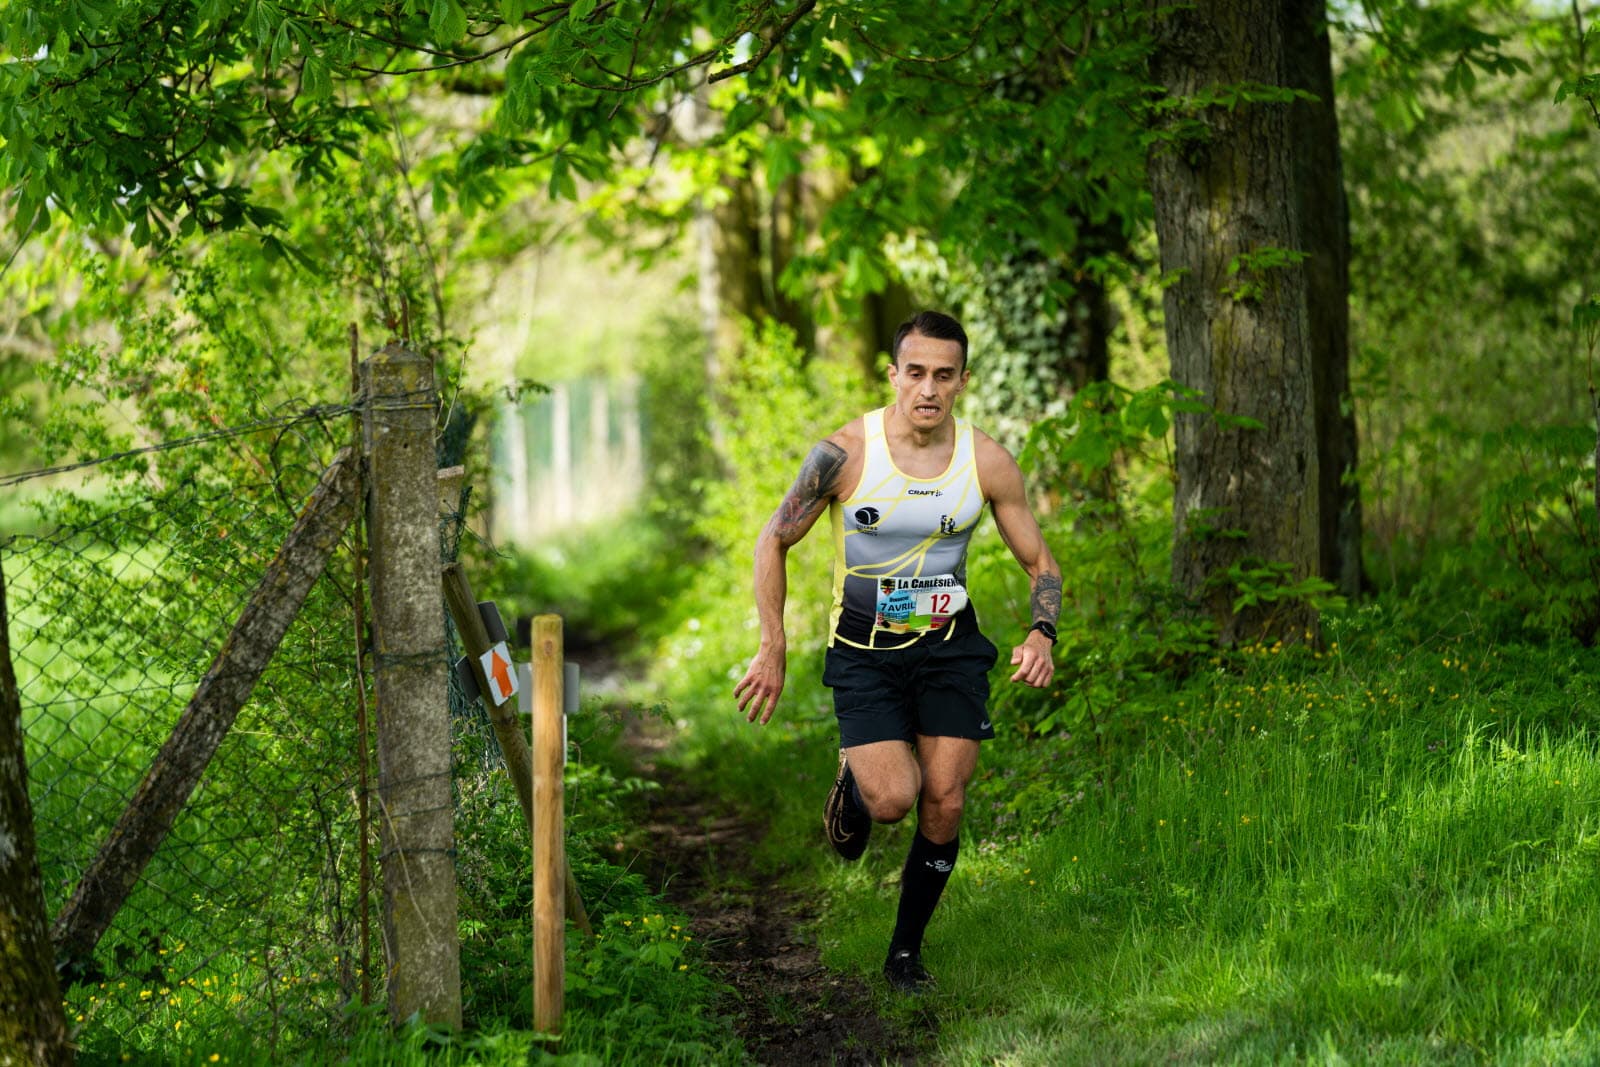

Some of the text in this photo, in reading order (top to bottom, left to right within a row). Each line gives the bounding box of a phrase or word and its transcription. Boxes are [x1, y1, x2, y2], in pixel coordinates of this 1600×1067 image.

[898, 579, 909, 589] LA
[880, 602, 916, 612] 7 AVRIL
[930, 593, 951, 613] 12
